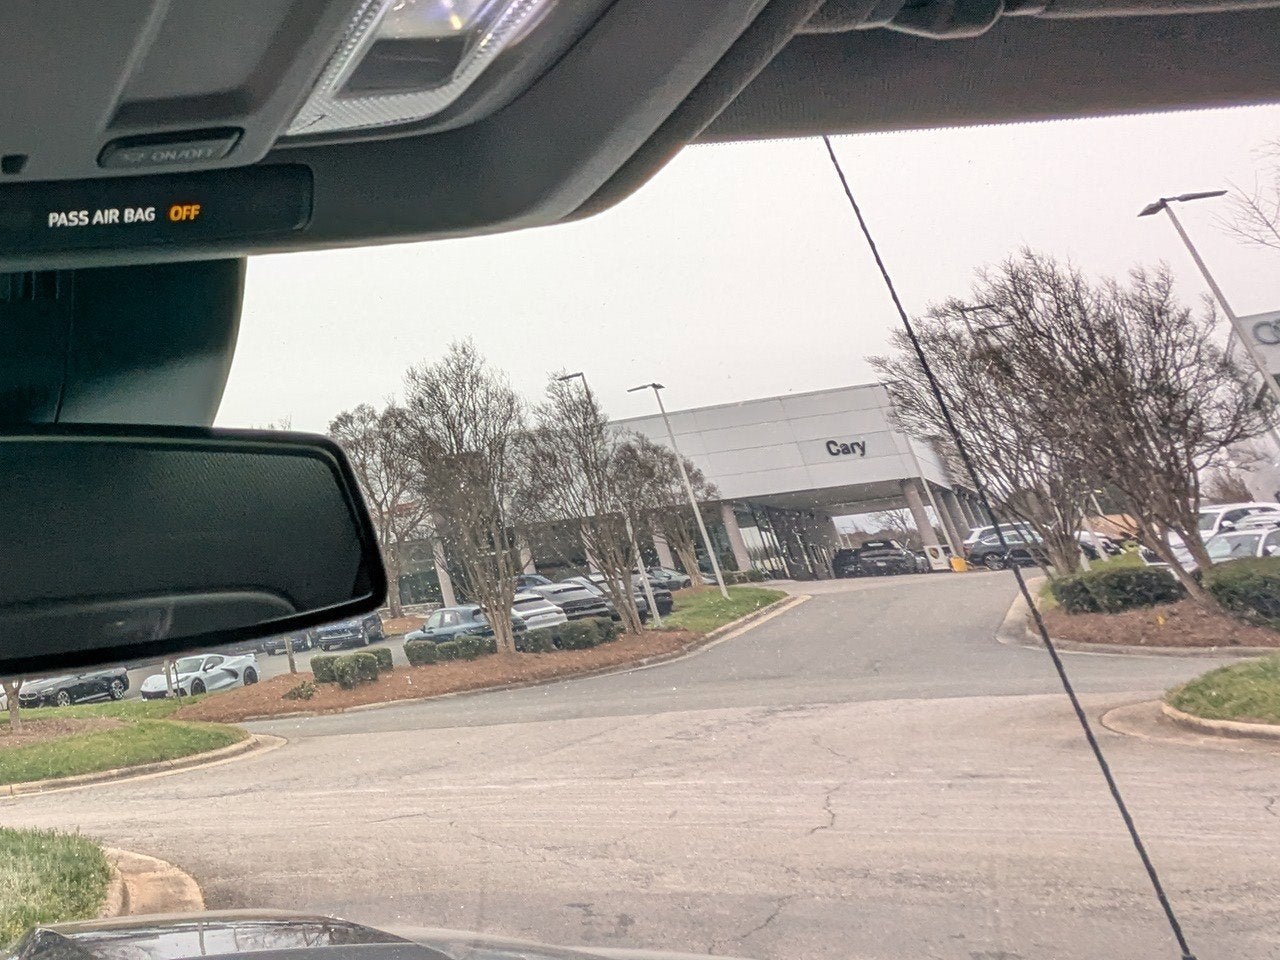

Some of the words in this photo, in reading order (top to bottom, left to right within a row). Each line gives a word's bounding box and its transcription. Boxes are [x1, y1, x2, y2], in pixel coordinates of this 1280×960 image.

[48, 209, 89, 228] PASS
[92, 208, 120, 226] AIR
[123, 206, 156, 224] BAG
[169, 204, 201, 222] OFF
[825, 440, 866, 457] Cary
